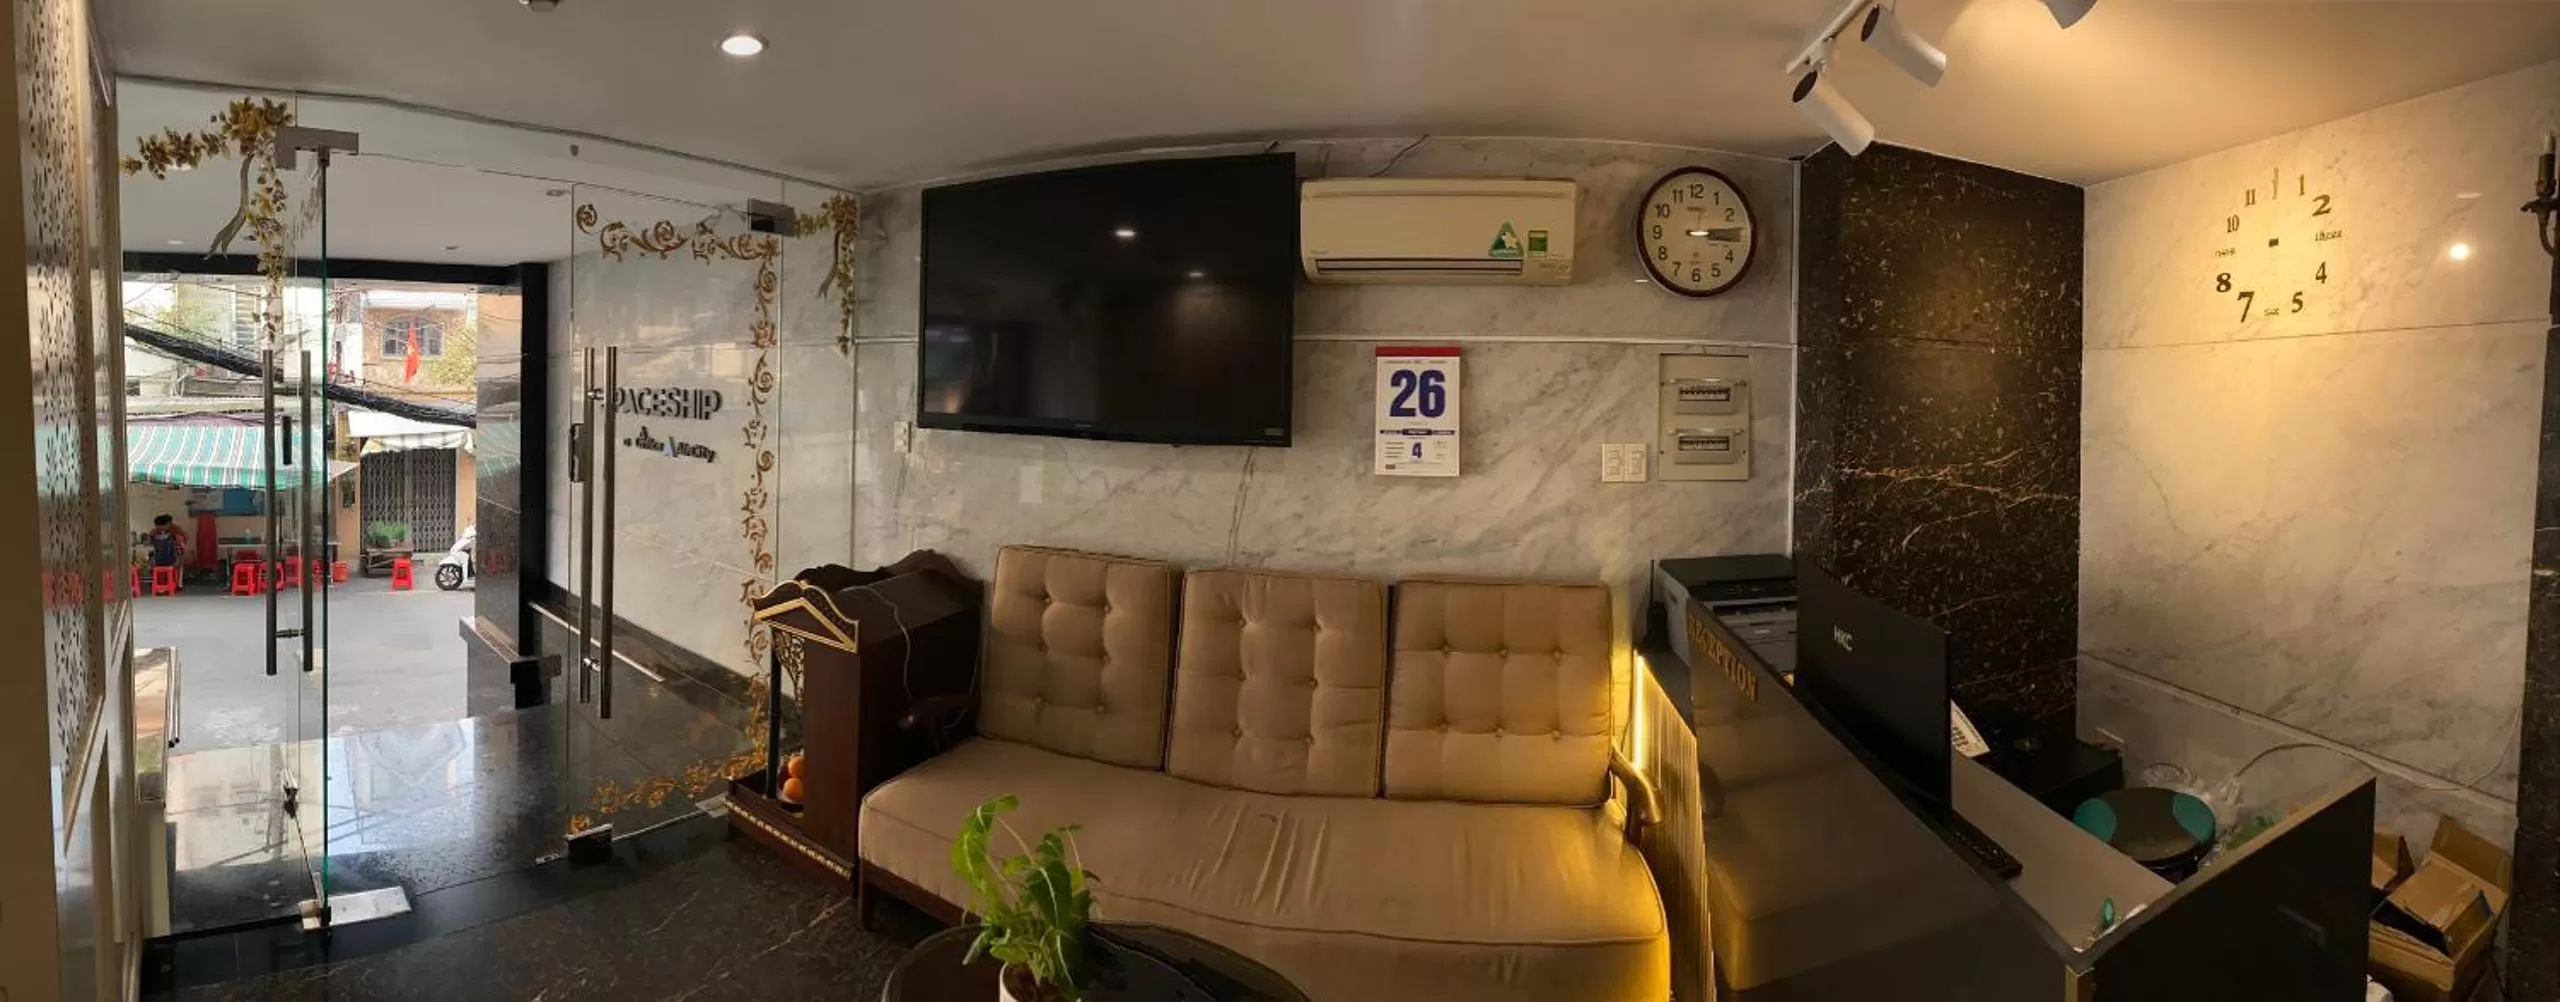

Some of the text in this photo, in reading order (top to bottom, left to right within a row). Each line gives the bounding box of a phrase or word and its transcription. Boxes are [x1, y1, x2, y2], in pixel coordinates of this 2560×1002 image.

[1672, 189, 1683, 204] 11
[1688, 183, 1704, 199] 12
[1713, 192, 1720, 206] 1
[2245, 188, 2256, 206] 11
[1655, 203, 1670, 219] 10
[2312, 194, 2331, 217] 2
[1724, 207, 1735, 222] 2
[2226, 214, 2240, 233] 10
[1652, 225, 1662, 240] 9
[1658, 246, 1668, 261] 8
[1725, 249, 1734, 264] 4
[1672, 261, 1682, 277] 7
[1692, 268, 1701, 282] 6
[1711, 262, 1721, 278] 5
[2315, 261, 2327, 284] 4
[2216, 272, 2232, 293] 8
[2237, 290, 2255, 323] 7
[2291, 291, 2304, 314] 5
[1389, 369, 1446, 418] 26
[597, 385, 723, 420] PACESHIP
[1412, 442, 1422, 459] 4
[1687, 613, 1758, 703] RECEPTION
